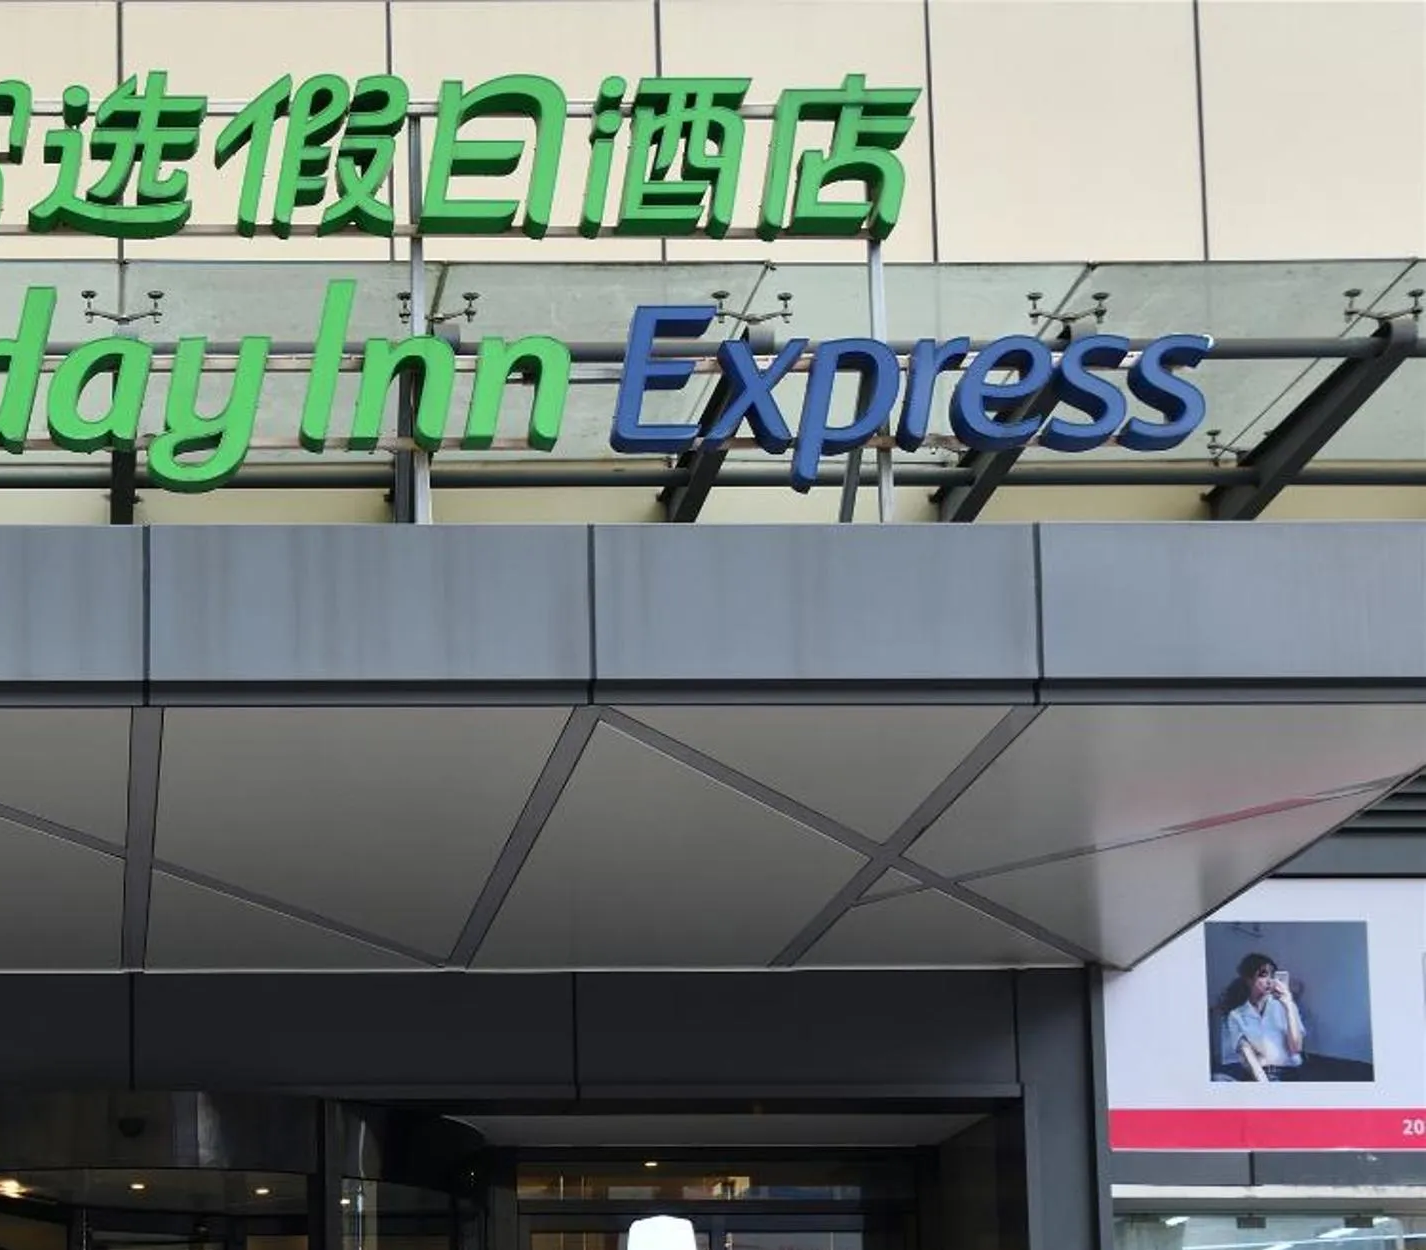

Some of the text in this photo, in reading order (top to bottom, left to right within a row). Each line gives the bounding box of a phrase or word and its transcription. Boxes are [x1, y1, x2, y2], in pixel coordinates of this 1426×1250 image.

[299, 280, 572, 453] Inn
[610, 305, 1210, 493] Express
[1403, 1119, 1425, 1135] 20
